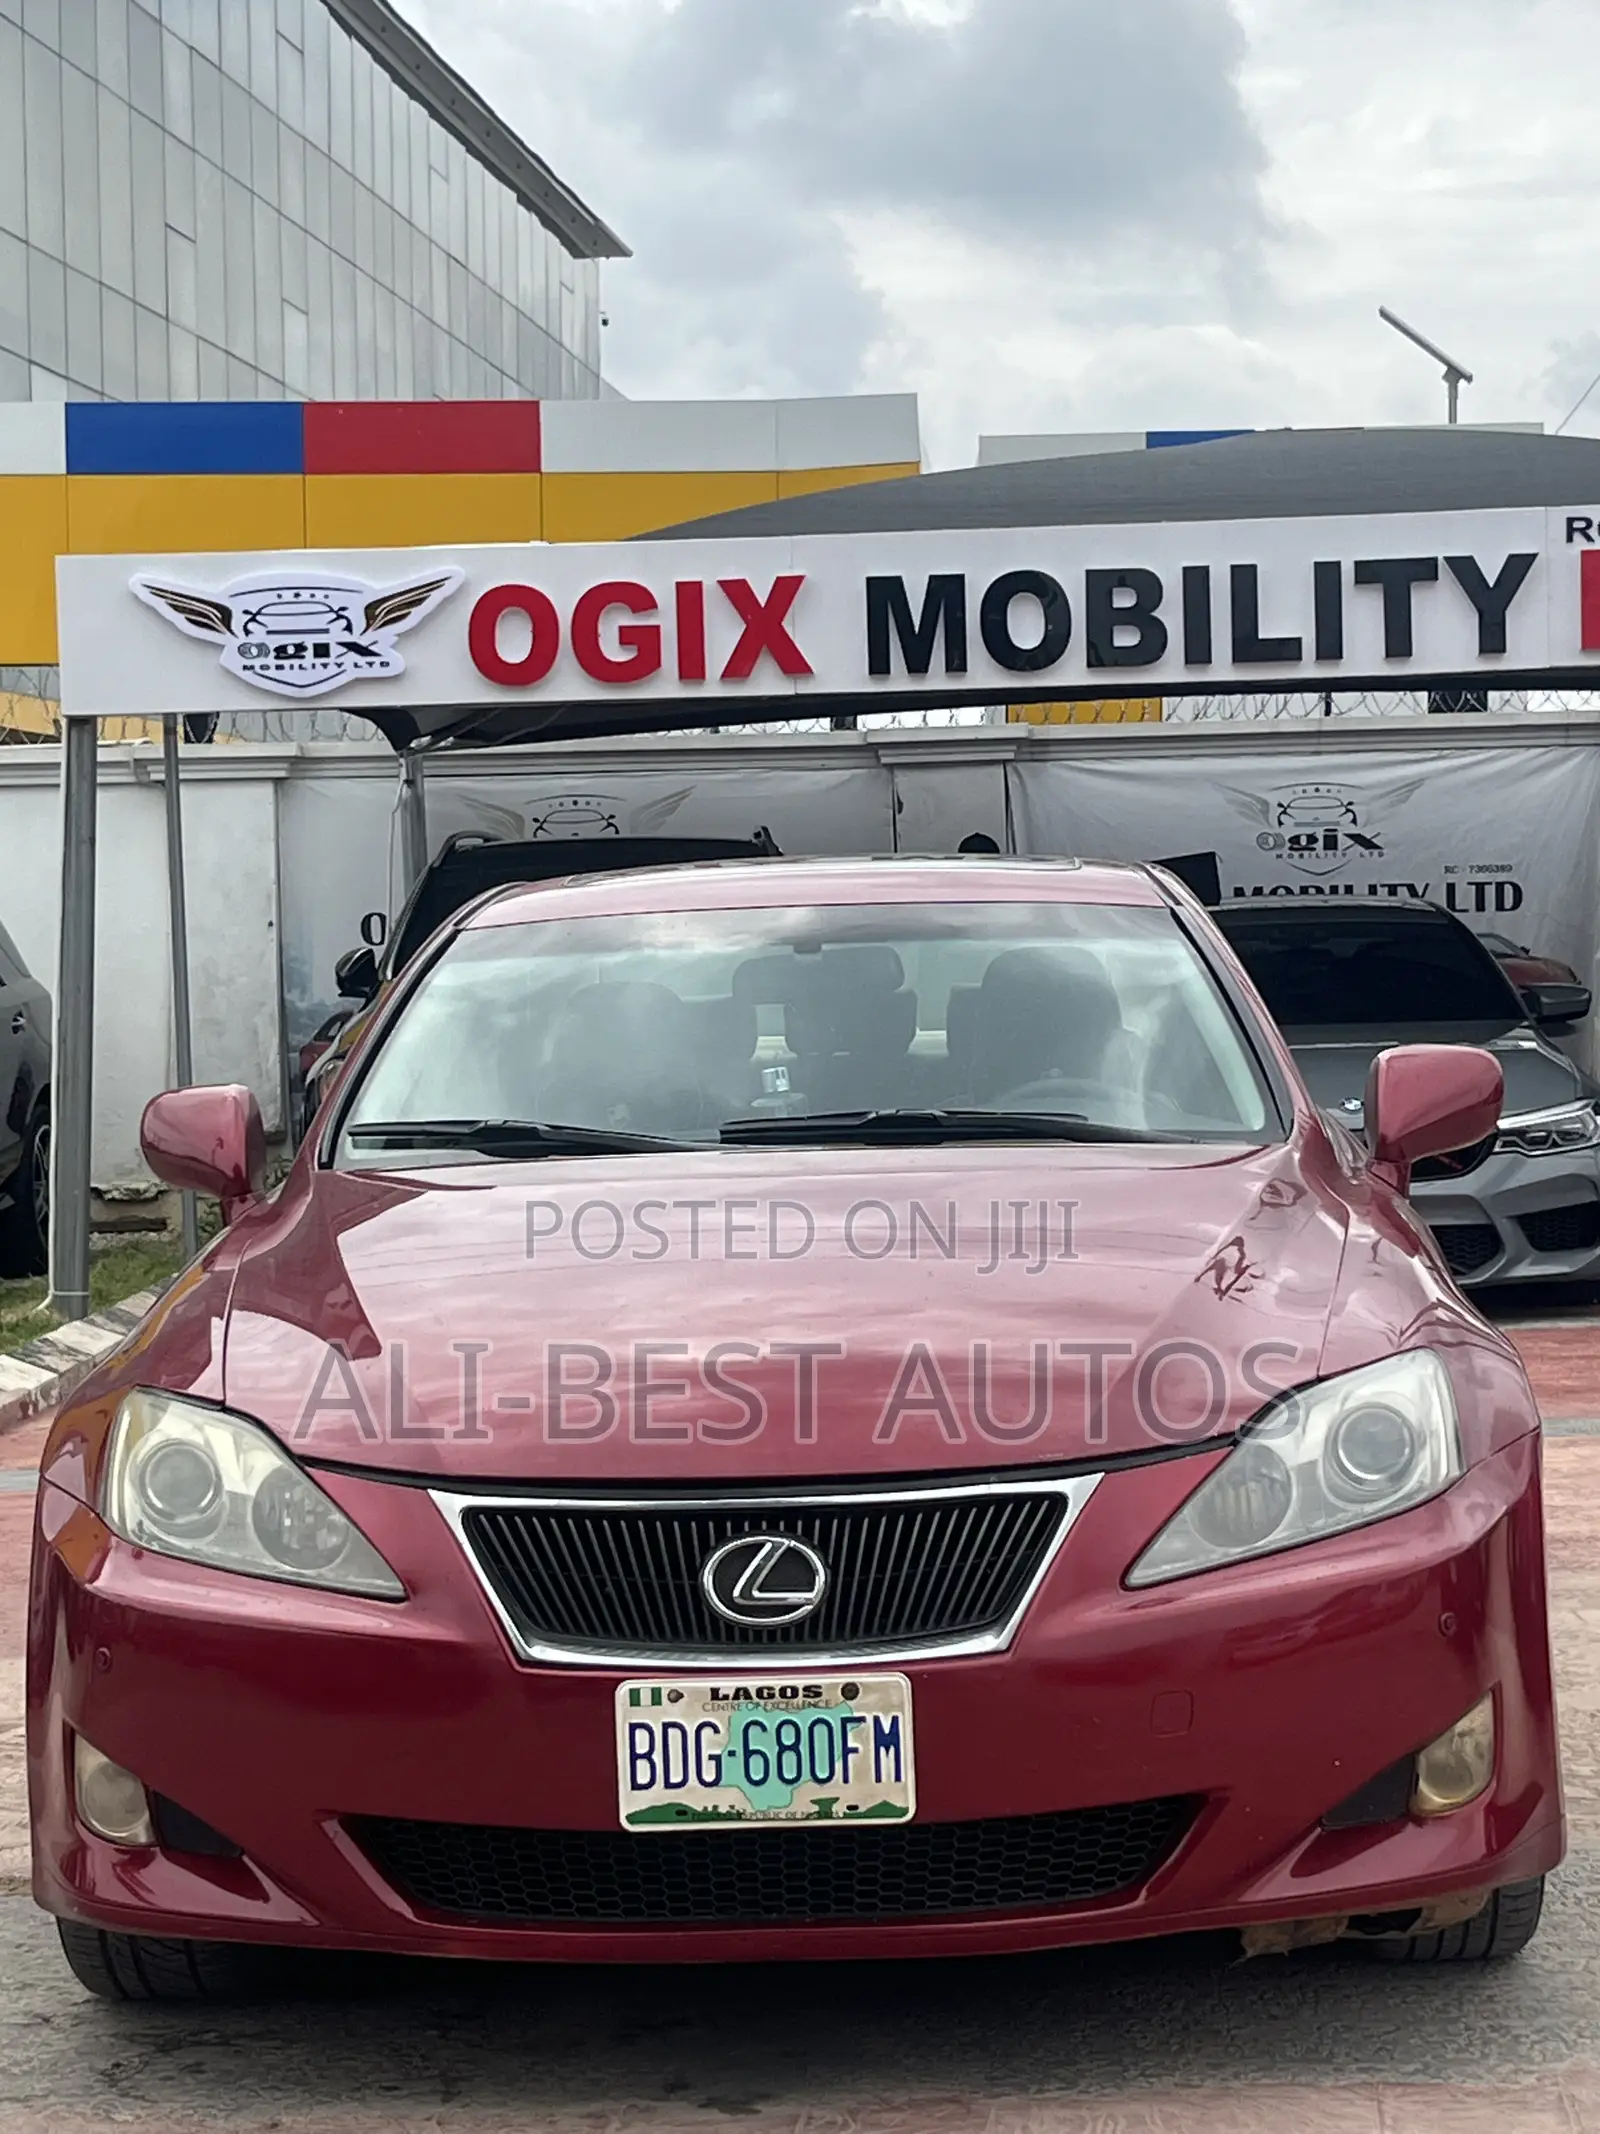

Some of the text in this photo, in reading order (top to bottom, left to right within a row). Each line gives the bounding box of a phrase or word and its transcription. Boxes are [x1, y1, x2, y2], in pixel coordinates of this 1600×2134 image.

[1565, 515, 1600, 543] R
[468, 575, 814, 686] OGIX
[866, 552, 1539, 676] MOBILITY
[242, 660, 390, 671] MOBILITY LTD
[1446, 880, 1523, 912] LTD
[702, 1701, 742, 1712] CENTRE
[710, 1685, 823, 1701] LAGOS
[628, 1715, 902, 1791] BDG-680FM
